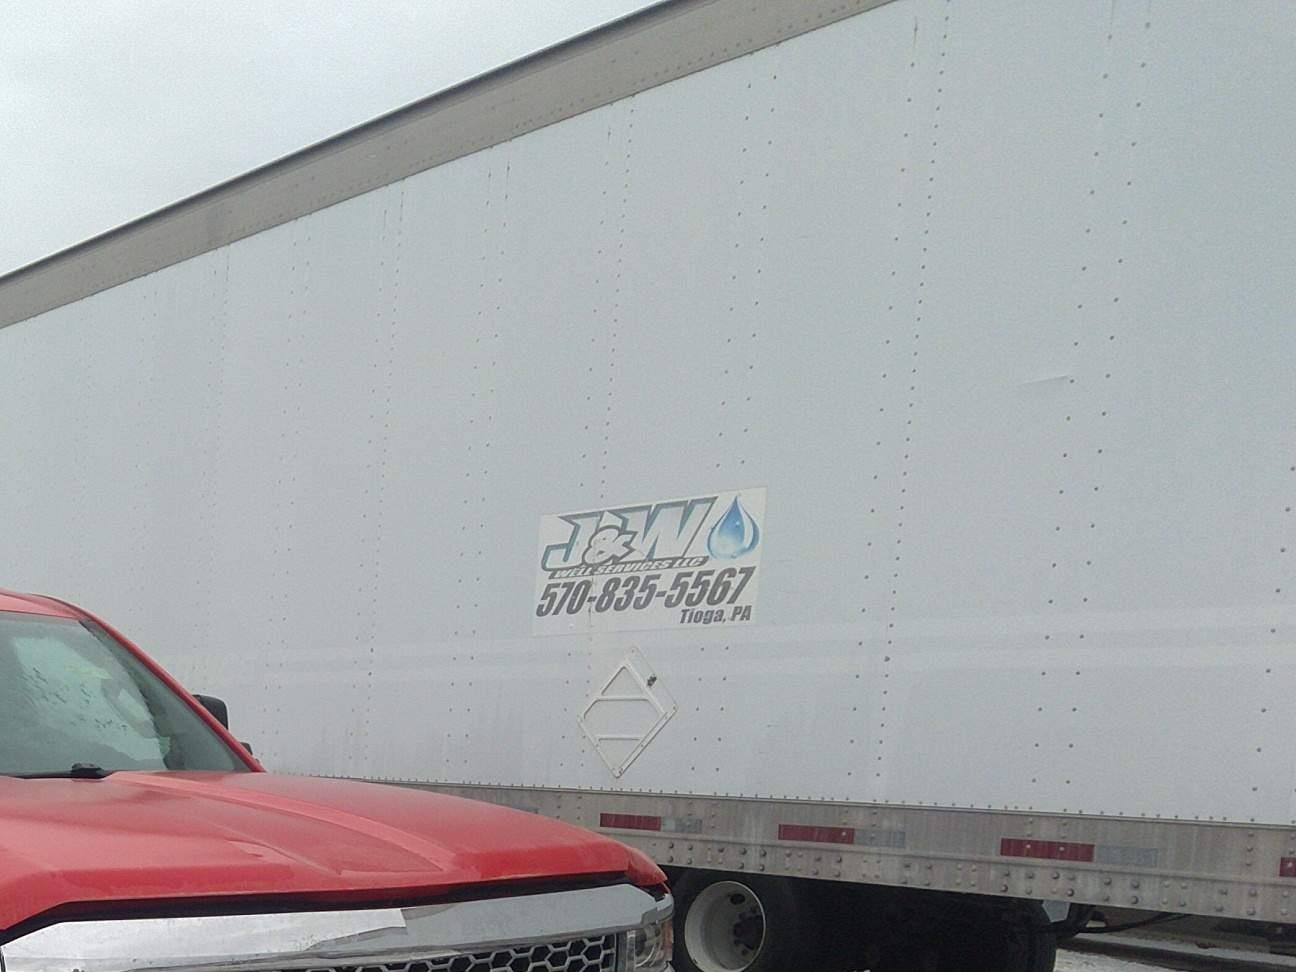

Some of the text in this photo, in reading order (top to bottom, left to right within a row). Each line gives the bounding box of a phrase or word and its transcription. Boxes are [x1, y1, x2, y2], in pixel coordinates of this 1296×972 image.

[541, 496, 718, 571] J&W
[555, 556, 705, 579] WELL SERVICES LLC
[536, 566, 756, 617] 570-835-5567
[680, 605, 753, 625] Tioga, PA
